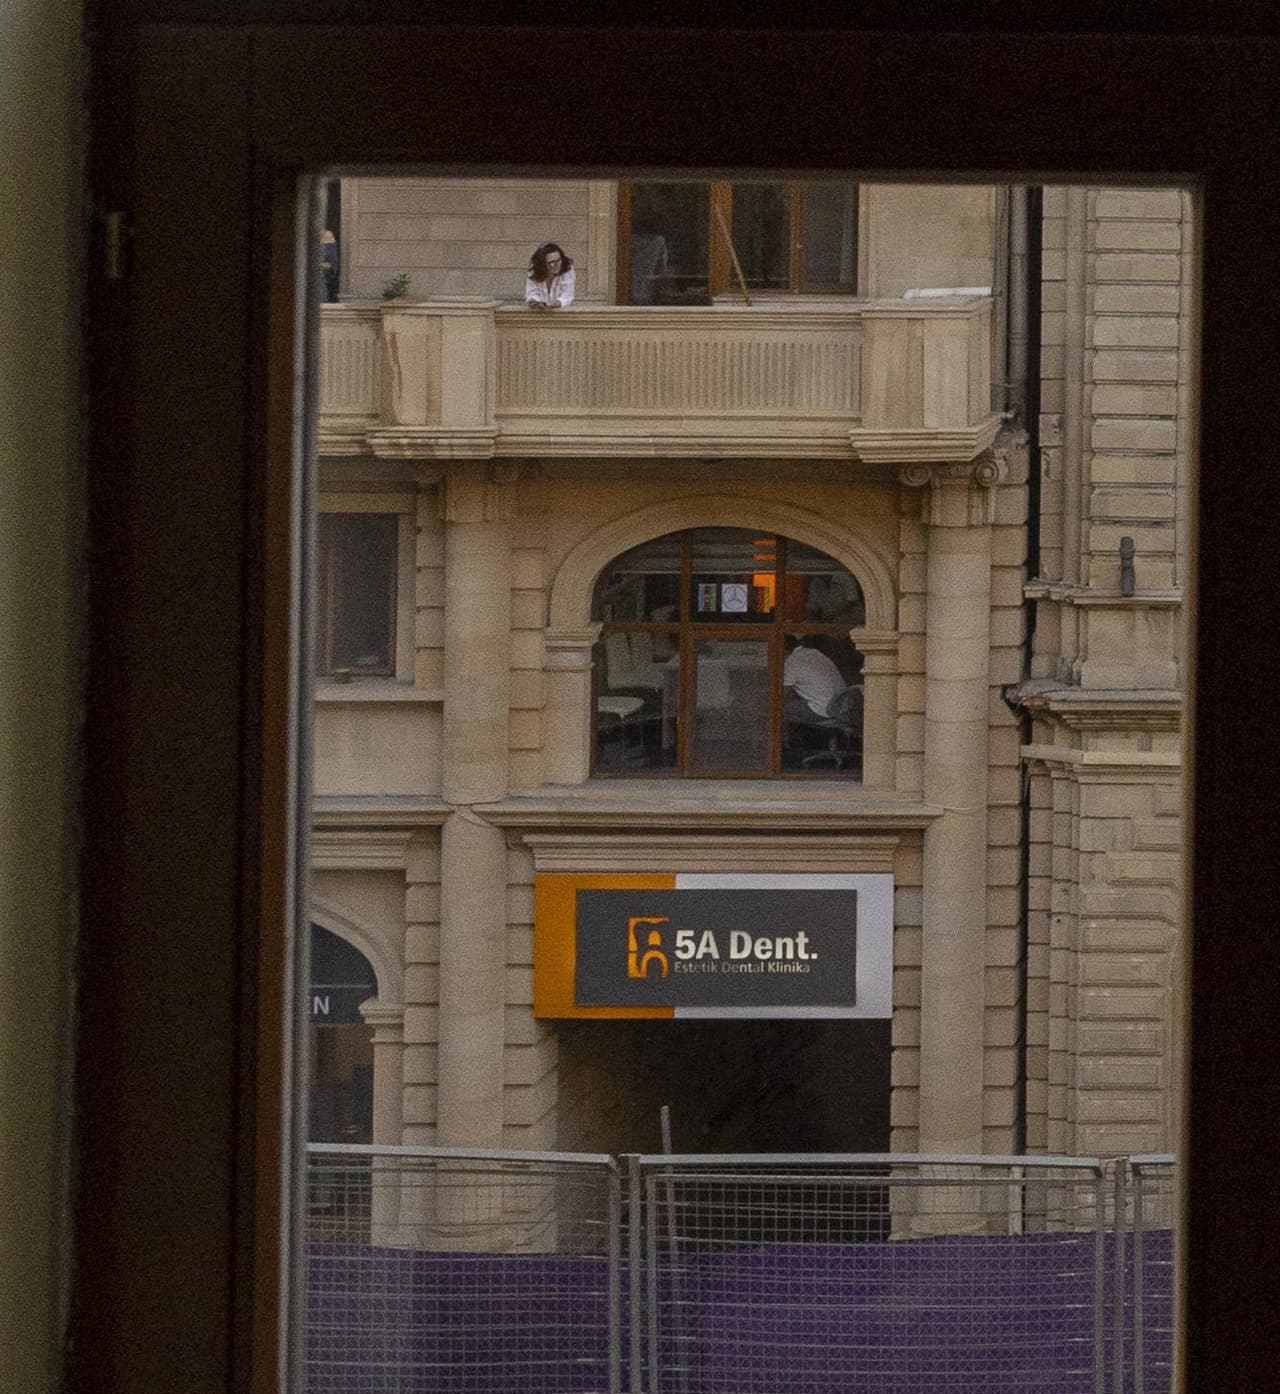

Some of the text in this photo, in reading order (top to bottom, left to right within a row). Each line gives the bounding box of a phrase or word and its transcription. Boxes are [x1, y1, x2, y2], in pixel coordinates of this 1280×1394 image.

[674, 929, 818, 960] 5A Dent.
[674, 960, 810, 974] Estetik Dental Klinika
[309, 995, 330, 1015] N
